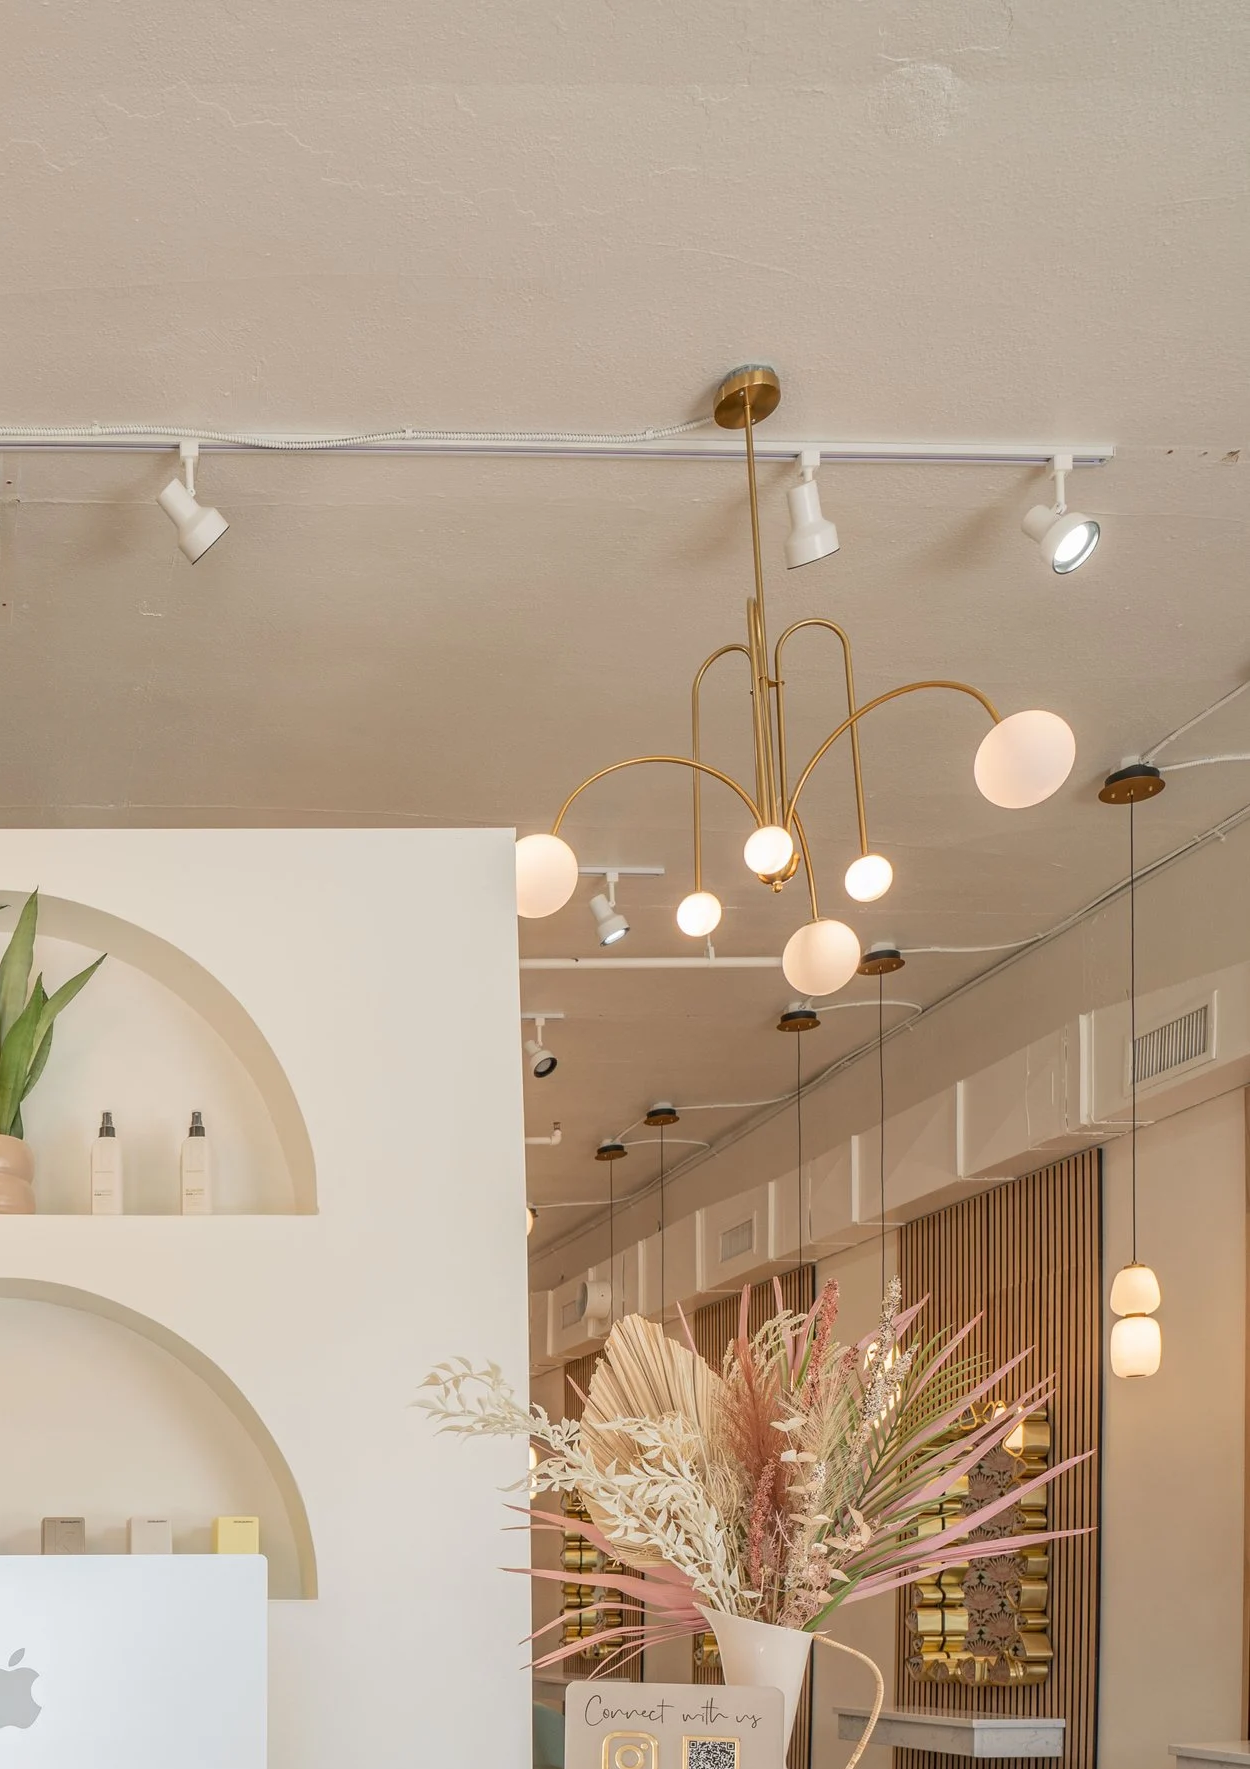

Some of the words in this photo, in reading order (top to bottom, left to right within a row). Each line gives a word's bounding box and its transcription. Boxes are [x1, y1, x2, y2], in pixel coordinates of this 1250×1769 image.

[584, 1694, 675, 1727] Connect
[682, 1697, 729, 1726] with
[735, 1714, 762, 1729] us
